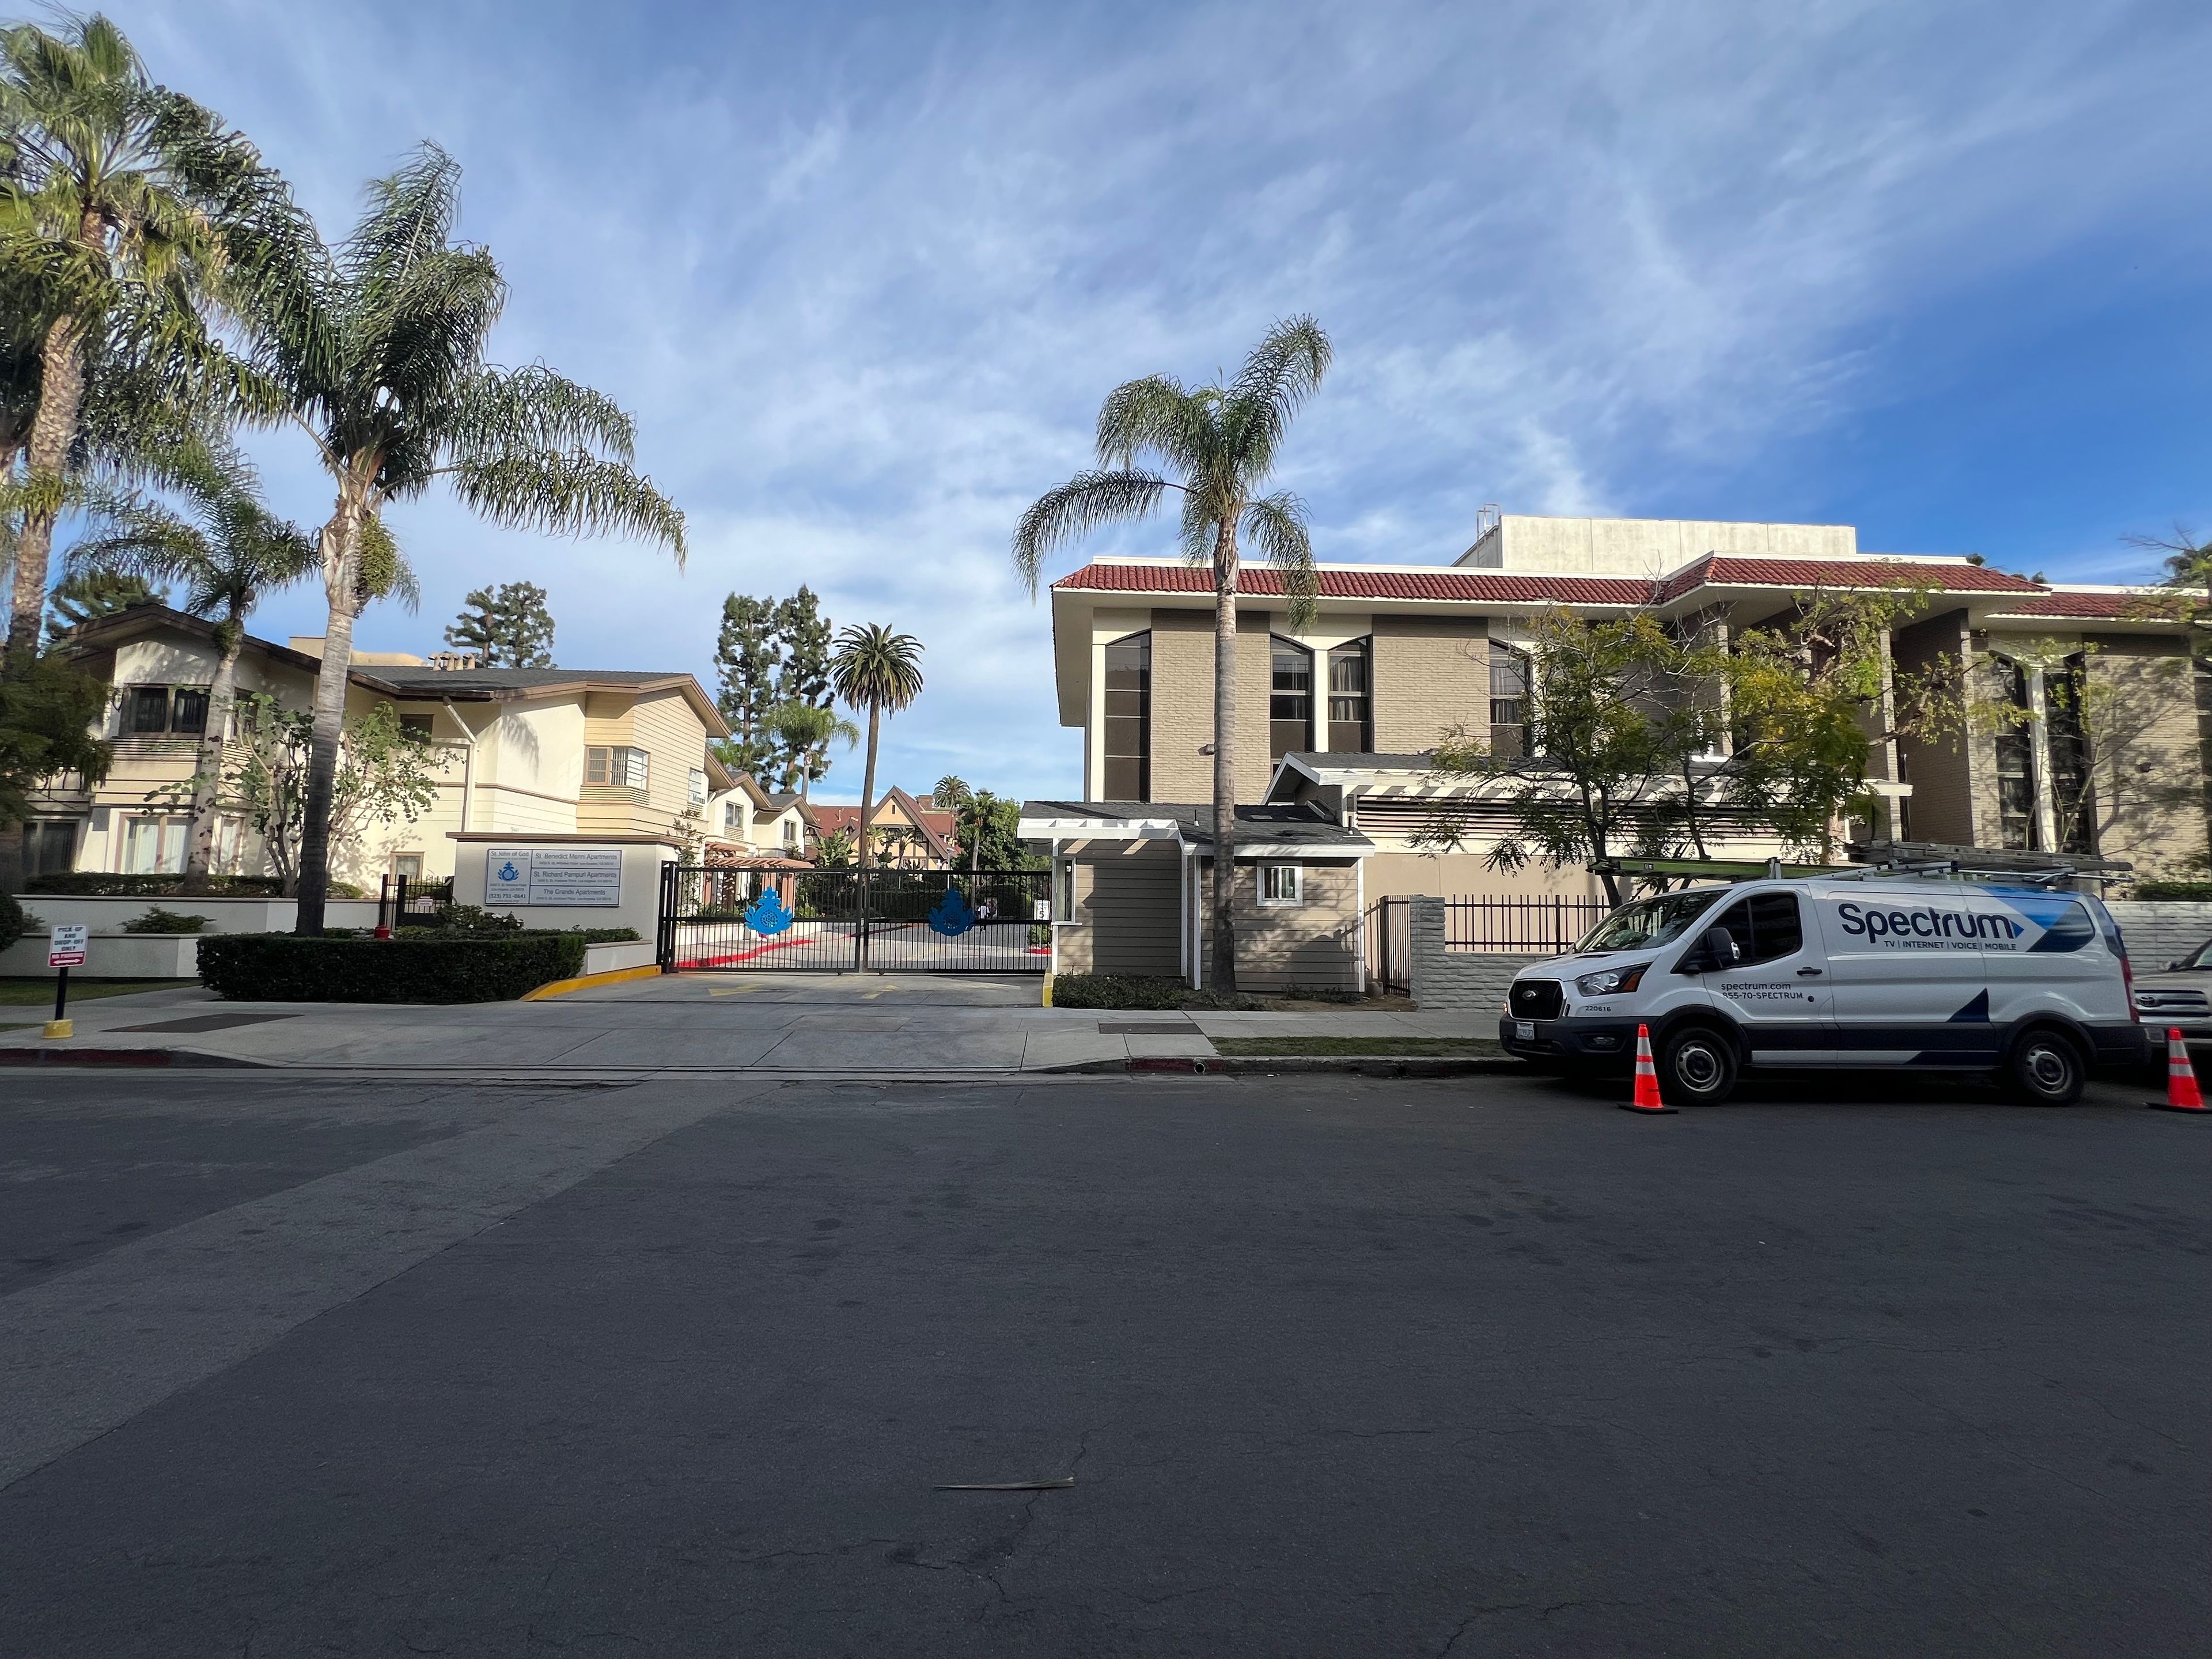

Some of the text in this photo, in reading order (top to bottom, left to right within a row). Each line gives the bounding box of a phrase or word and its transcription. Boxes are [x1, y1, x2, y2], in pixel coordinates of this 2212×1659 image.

[1838, 903, 2015, 944] Spectrum
[1884, 940, 1895, 948] TV
[1903, 941, 1944, 949] INTERNET
[1721, 982, 1791, 991] spectrum.com
